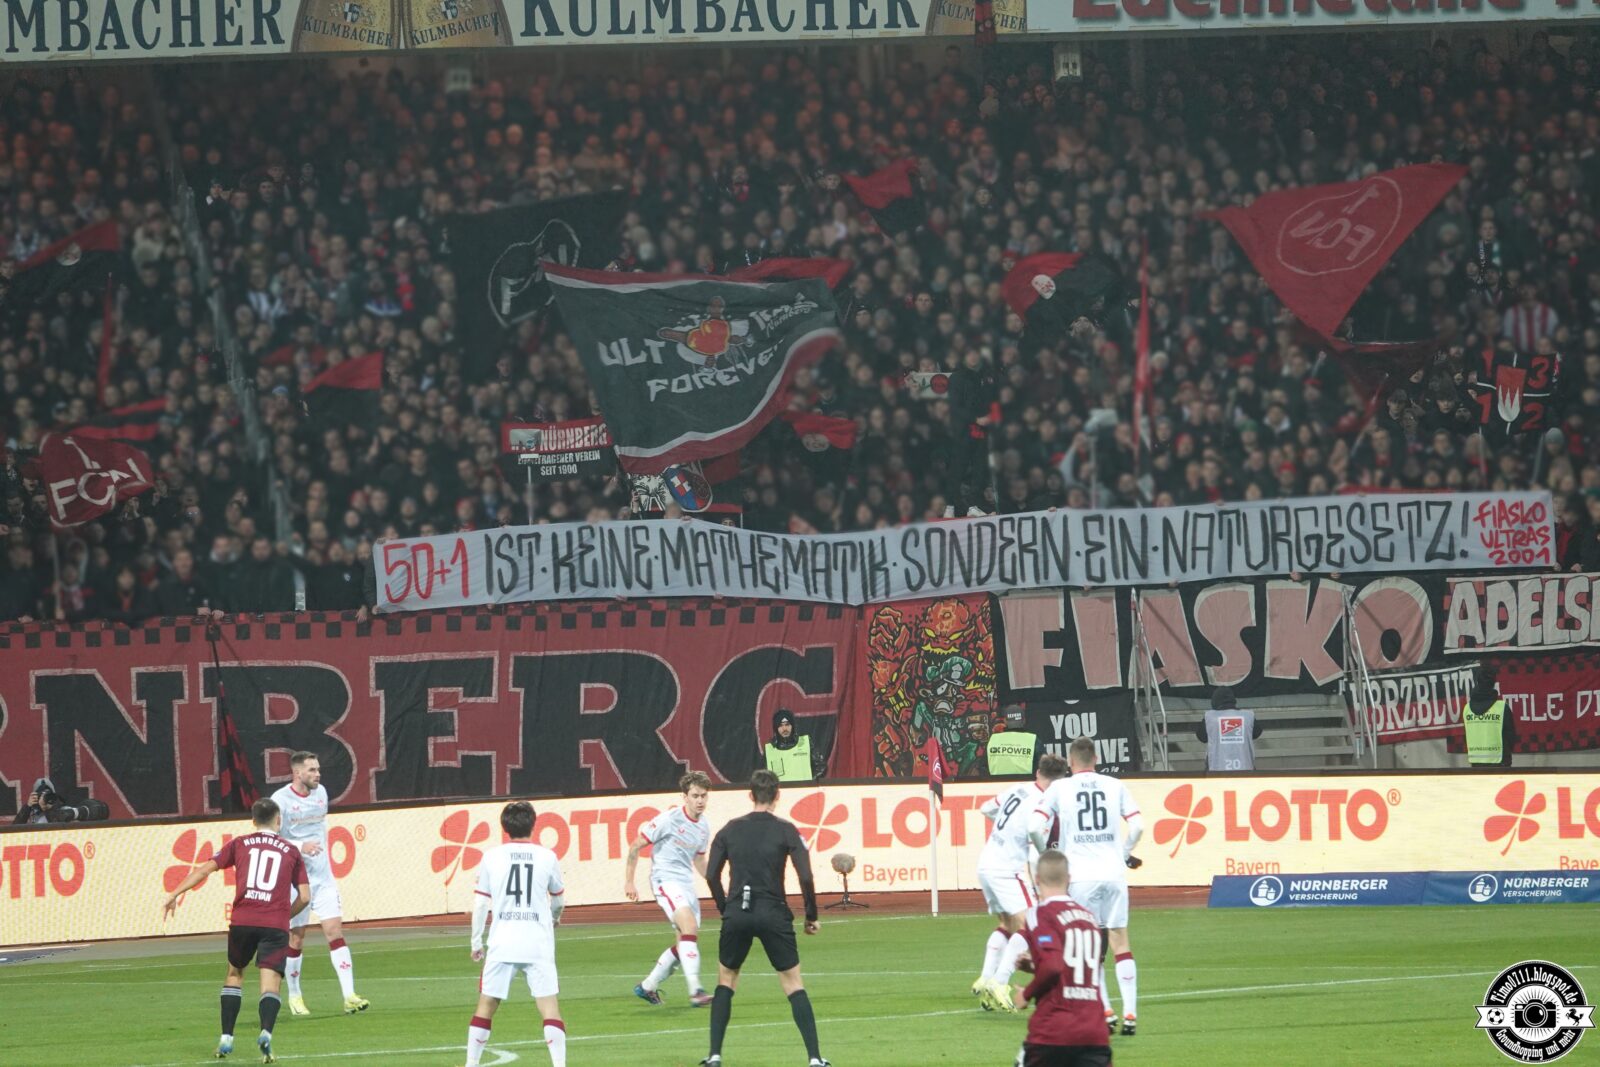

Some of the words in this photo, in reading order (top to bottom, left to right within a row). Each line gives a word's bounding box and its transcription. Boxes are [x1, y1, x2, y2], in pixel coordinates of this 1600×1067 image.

[303, 15, 393, 46] KULMBACHER
[937, 2, 1027, 32] KULMCHER
[1528, 356, 1550, 389] 3
[1521, 401, 1544, 430] 2
[540, 424, 608, 451] NÜRNBERG
[575, 449, 600, 462] VEREIN
[540, 466, 556, 476] SEIT
[558, 464, 577, 475] 1900
[50, 458, 147, 520] FCN
[1479, 526, 1552, 549] ULTRAS
[383, 537, 469, 604] 50+1
[1162, 500, 1470, 575] NATURGESETZ!
[1488, 547, 1552, 566] 2001
[1444, 575, 1600, 648] ADELS
[999, 578, 1433, 689] FIASKO
[0, 644, 838, 810] NBERG
[1050, 712, 1098, 740] YOU
[1002, 747, 1031, 756] POWER
[1225, 760, 1240, 770] 20
[1076, 790, 1108, 832] 26
[246, 847, 282, 891] 10
[863, 864, 928, 885] Bayern
[1225, 858, 1280, 875] Bayern
[505, 863, 534, 908] 41
[1289, 893, 1358, 901] VERSICHERUNG
[1290, 879, 1388, 891] NÜRNBERGER
[1503, 889, 1562, 898] VERSICHERUNG
[1504, 877, 1589, 889] NÜRNBERGER
[1063, 927, 1102, 986] 44
